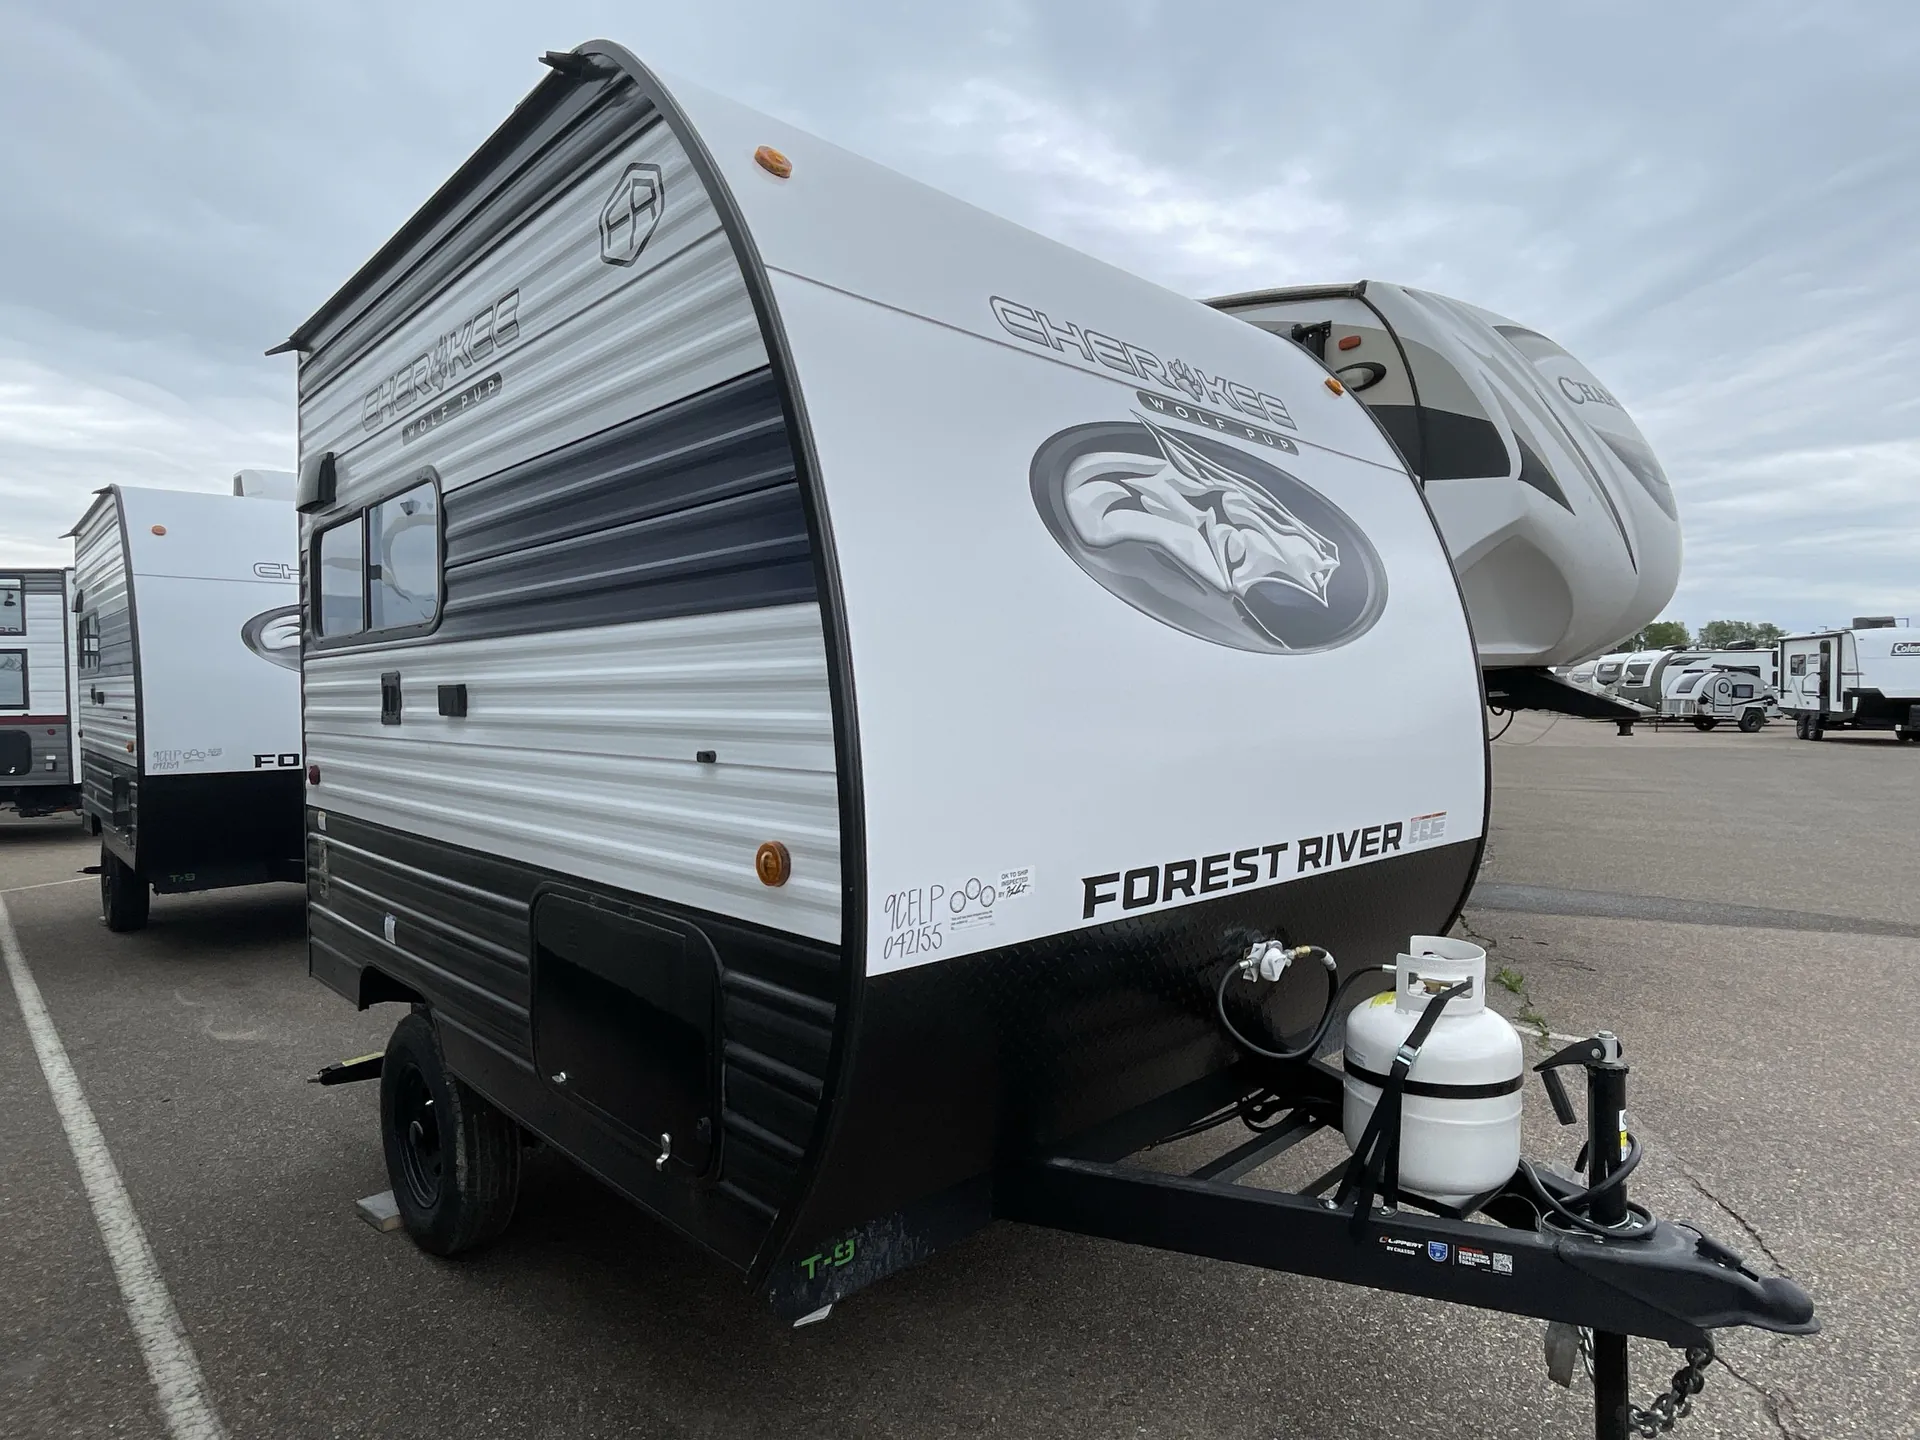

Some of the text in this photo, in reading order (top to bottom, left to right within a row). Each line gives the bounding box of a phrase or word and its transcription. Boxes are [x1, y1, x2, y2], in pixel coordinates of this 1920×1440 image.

[407, 379, 496, 437] WOLF PUP
[1148, 396, 1289, 451] WOLF PUP
[1001, 876, 1029, 887] INSPECTED
[1017, 869, 1029, 877] SHIP
[1081, 821, 1402, 920] FOREST RIVER
[883, 923, 943, 960] 042155
[801, 1239, 855, 1280] T-9
